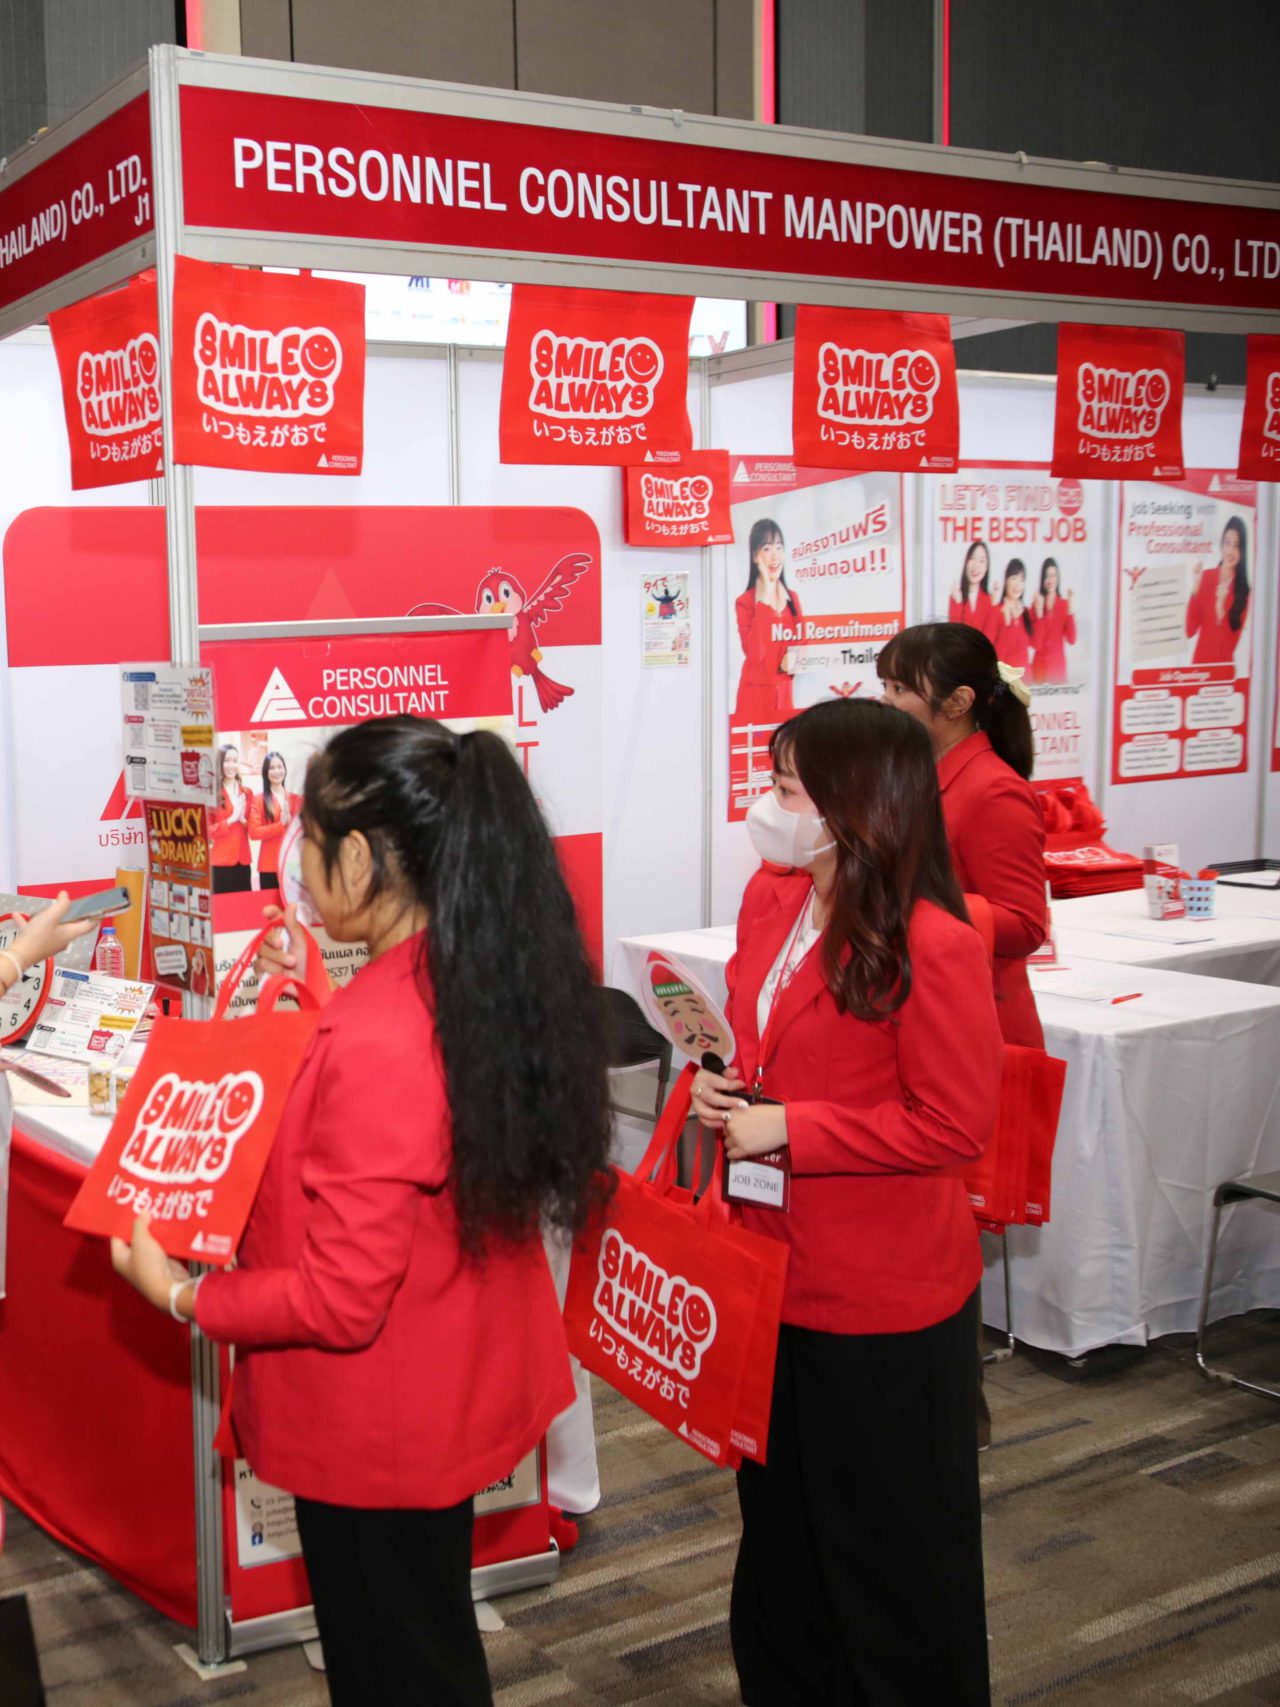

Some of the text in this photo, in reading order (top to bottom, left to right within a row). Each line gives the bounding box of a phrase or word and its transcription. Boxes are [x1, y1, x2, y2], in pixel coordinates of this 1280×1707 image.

[70, 182, 105, 225] CO.,
[107, 154, 148, 204] LTD.
[134, 192, 150, 226] J1
[233, 138, 507, 212] PERSONNEL
[519, 166, 773, 236] CONSULTANT
[783, 194, 983, 255] MANPOWER
[993, 216, 1163, 280] (THAILAND)
[1172, 233, 1225, 280] CO.,
[196, 316, 303, 377] SMILE
[532, 333, 627, 379] SMILE
[79, 345, 142, 400] SMILE
[821, 346, 910, 390] SMILE
[200, 367, 331, 411] ALWAYS
[533, 378, 650, 415] ALWAYS
[1080, 366, 1147, 406] SMILE
[83, 384, 160, 430] ALWAYS
[820, 389, 929, 422] ALWAYS
[1081, 406, 1158, 436] ALWAYS
[643, 474, 690, 500] SMILE
[940, 484, 999, 511] LET'S
[645, 500, 706, 519] ALWAYS
[939, 516, 1088, 543] THE BEST JOB
[771, 619, 900, 643] No.1 Recruitment
[322, 664, 448, 691] PERSONNEL
[307, 690, 449, 720] CONSULTANT
[98, 826, 145, 848] บริษัท
[151, 807, 203, 838] LUCKY
[32, 976, 41, 991] 3
[10, 1012, 19, 1027] 5
[23, 997, 32, 1012] 4
[124, 1127, 230, 1177] ALWAYS
[731, 1173, 780, 1193] JOB ZONE
[601, 1235, 687, 1328] SMILE
[596, 1280, 698, 1373] ALWAYS
